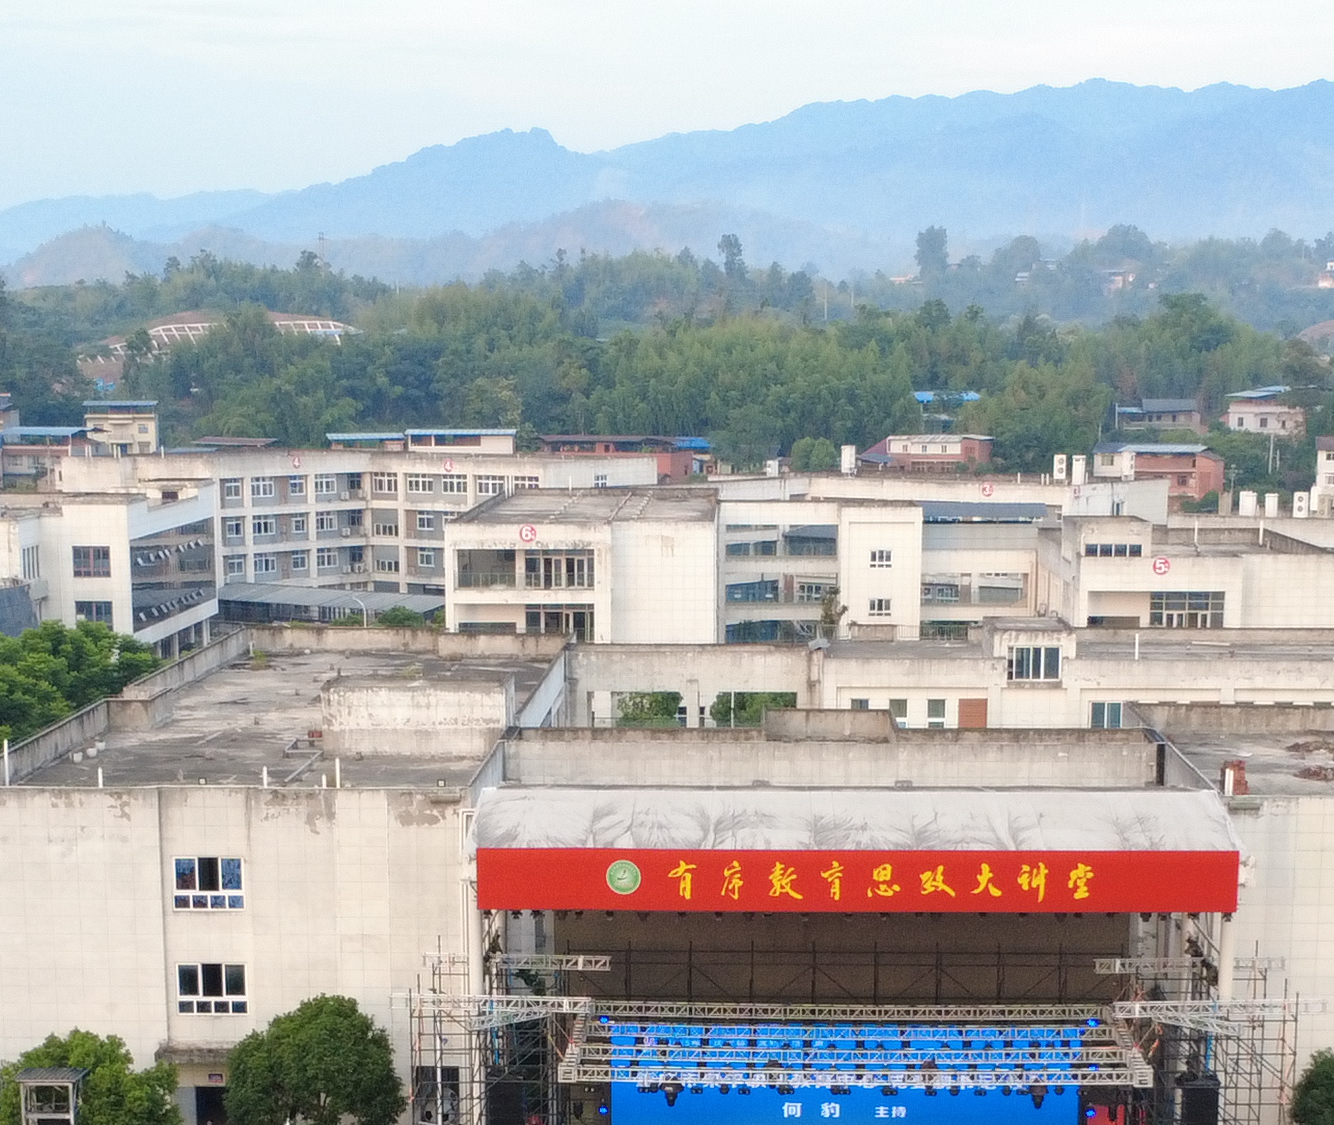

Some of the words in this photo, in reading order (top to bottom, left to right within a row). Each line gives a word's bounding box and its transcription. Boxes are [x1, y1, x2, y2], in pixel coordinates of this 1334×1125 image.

[668, 860, 1095, 903] 有序教育思政大讲堂
